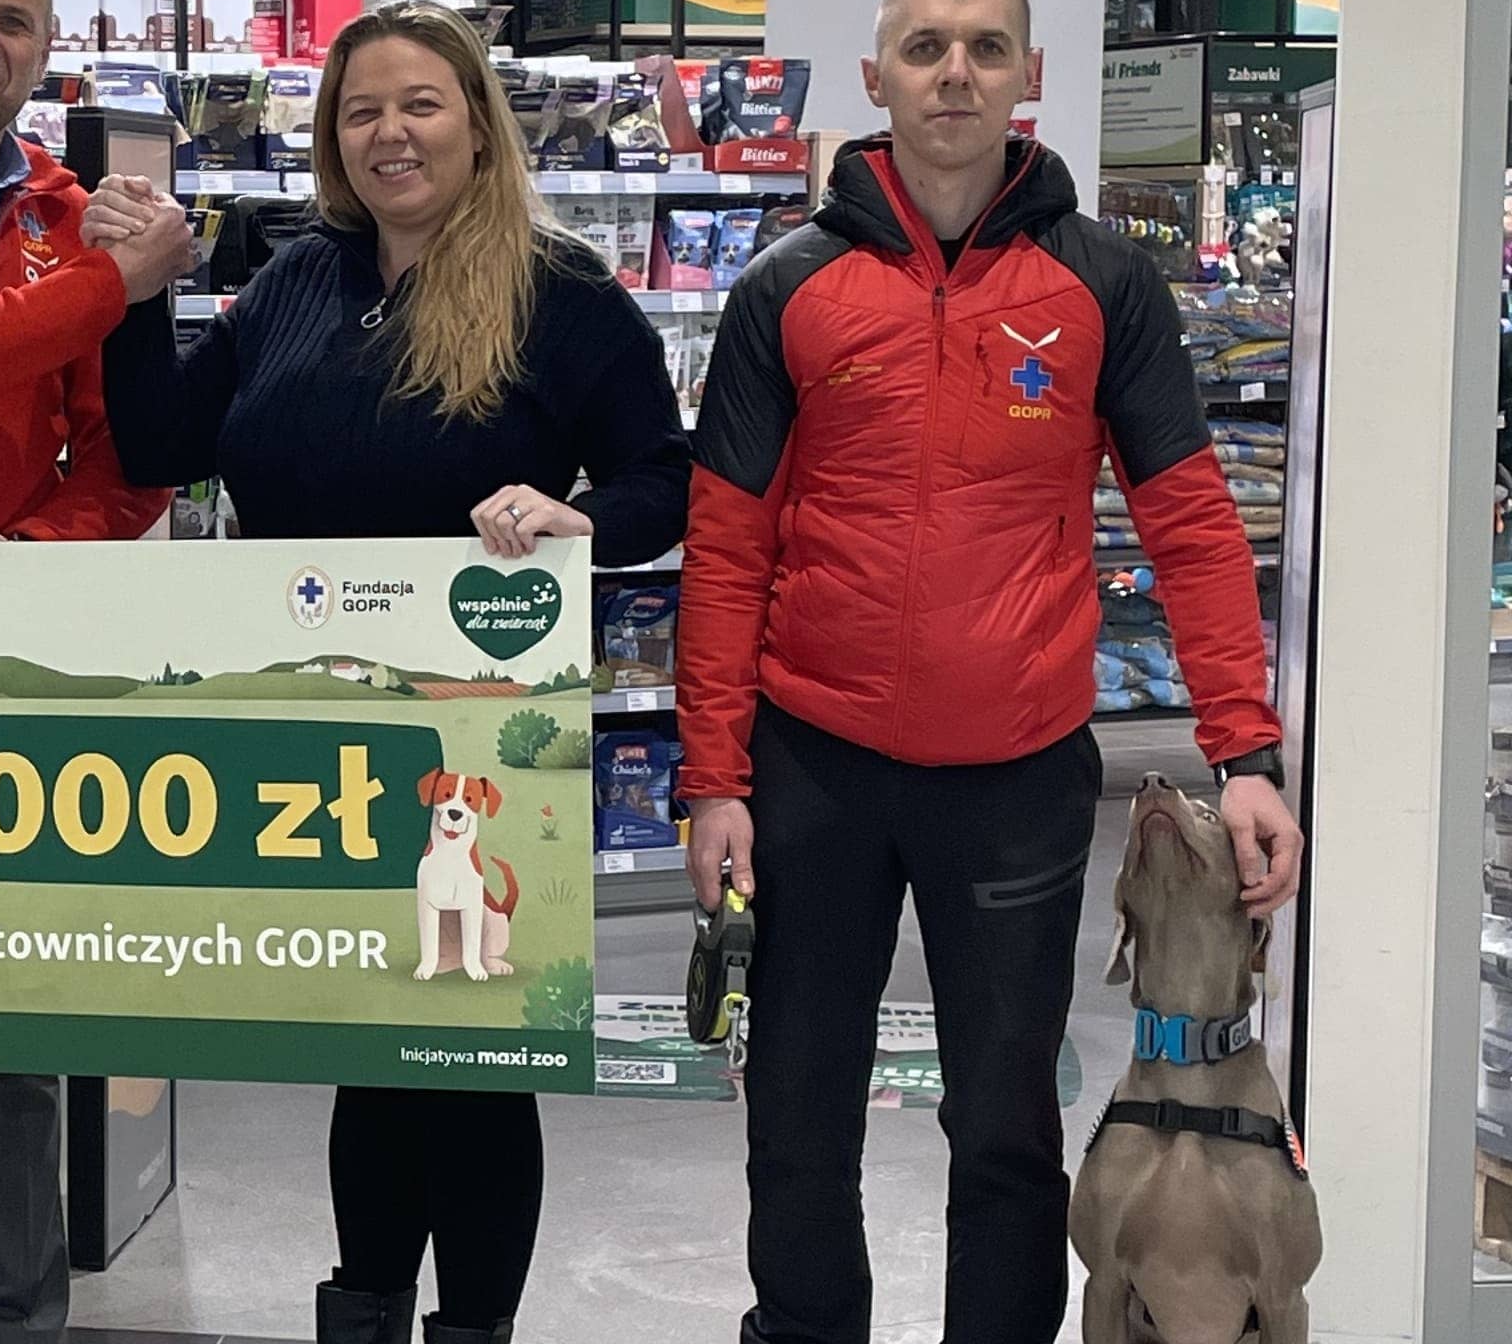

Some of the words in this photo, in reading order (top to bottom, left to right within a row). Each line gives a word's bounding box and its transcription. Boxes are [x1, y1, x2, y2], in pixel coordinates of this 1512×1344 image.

[1227, 66, 1281, 82] Zabawki
[740, 147, 788, 162] Bitties
[1008, 404, 1052, 421] GOPR
[342, 580, 414, 595] Fundacja
[342, 599, 391, 613] GOPR
[457, 596, 531, 614] wspólnie
[465, 615, 489, 630] dla
[255, 744, 387, 861] zł
[255, 924, 389, 972] GOPR
[400, 1046, 475, 1067] Inicjatywa
[477, 1046, 528, 1066] maxi
[530, 1050, 569, 1067] zoo
